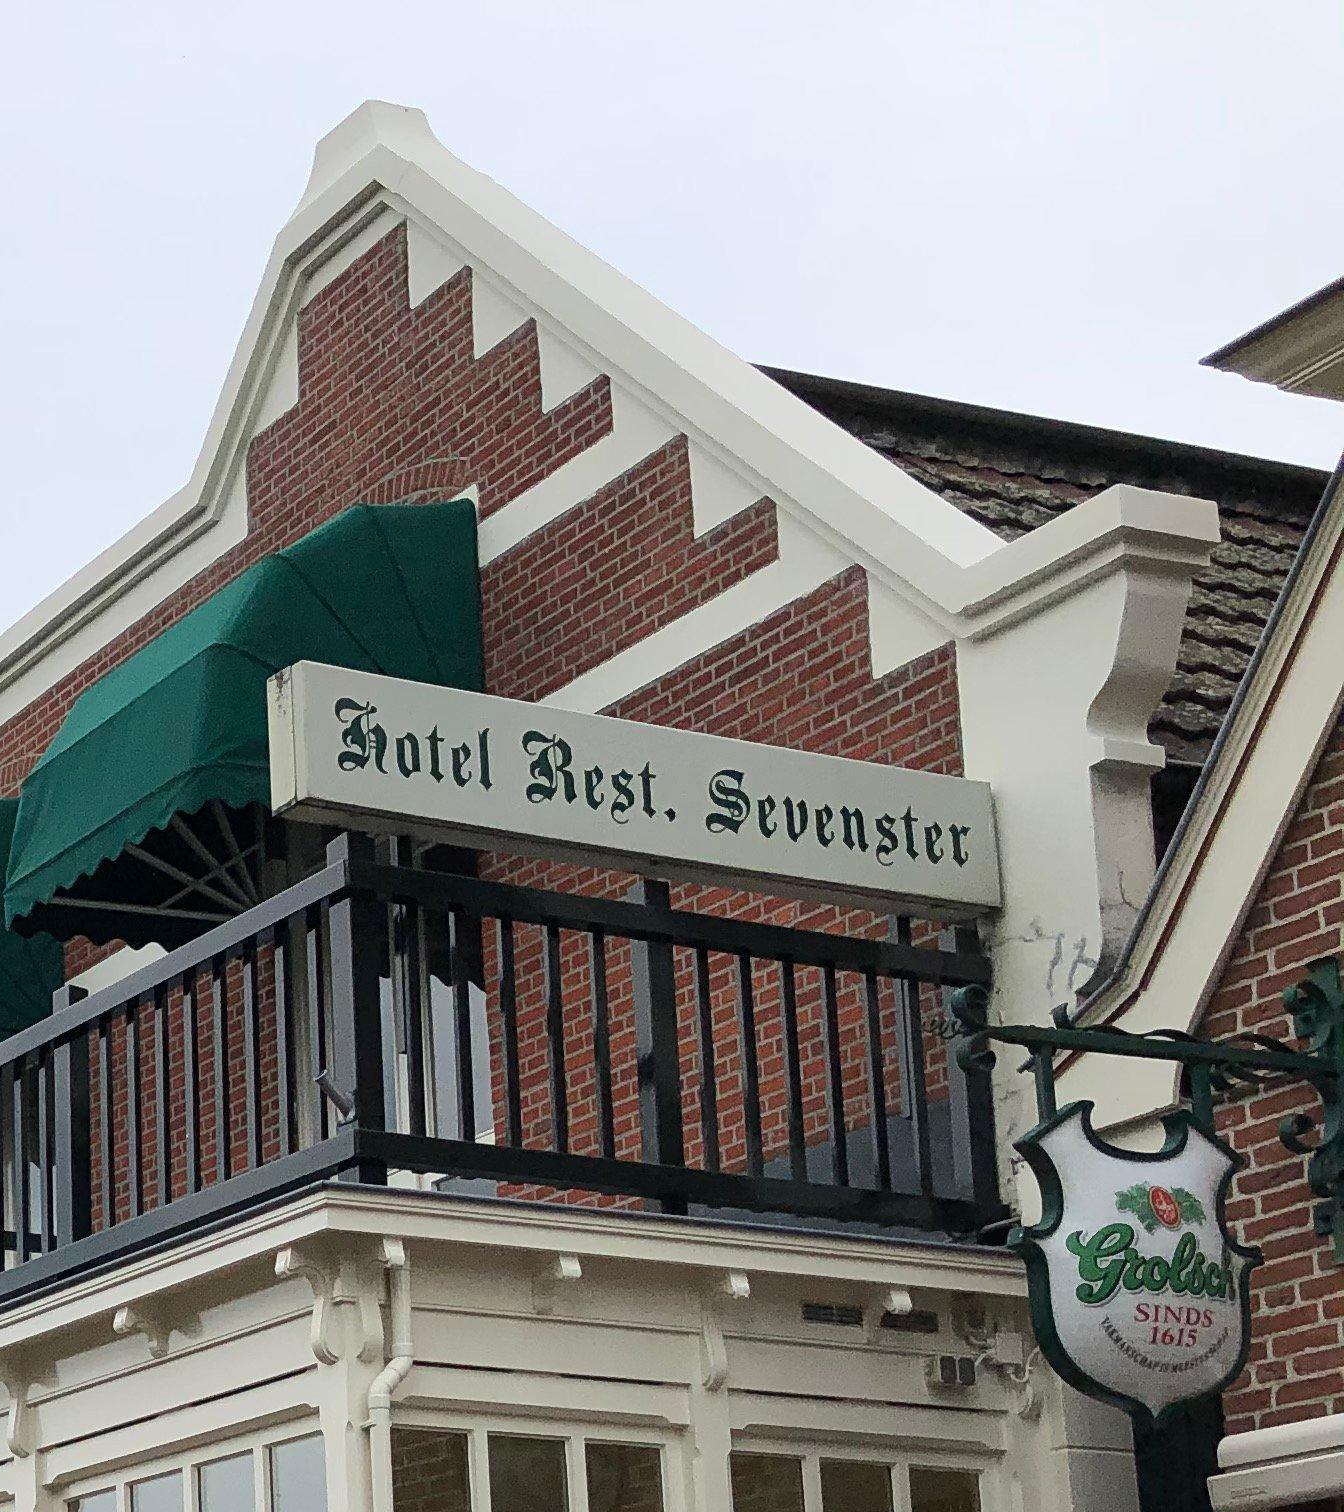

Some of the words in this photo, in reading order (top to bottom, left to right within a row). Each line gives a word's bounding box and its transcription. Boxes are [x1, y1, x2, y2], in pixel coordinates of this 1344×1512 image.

[333, 697, 491, 791] Hotel
[522, 730, 677, 824] Rest.
[706, 769, 972, 868] Sevenster
[1133, 1303, 1214, 1328] SINDS
[1149, 1326, 1198, 1347] 1615
